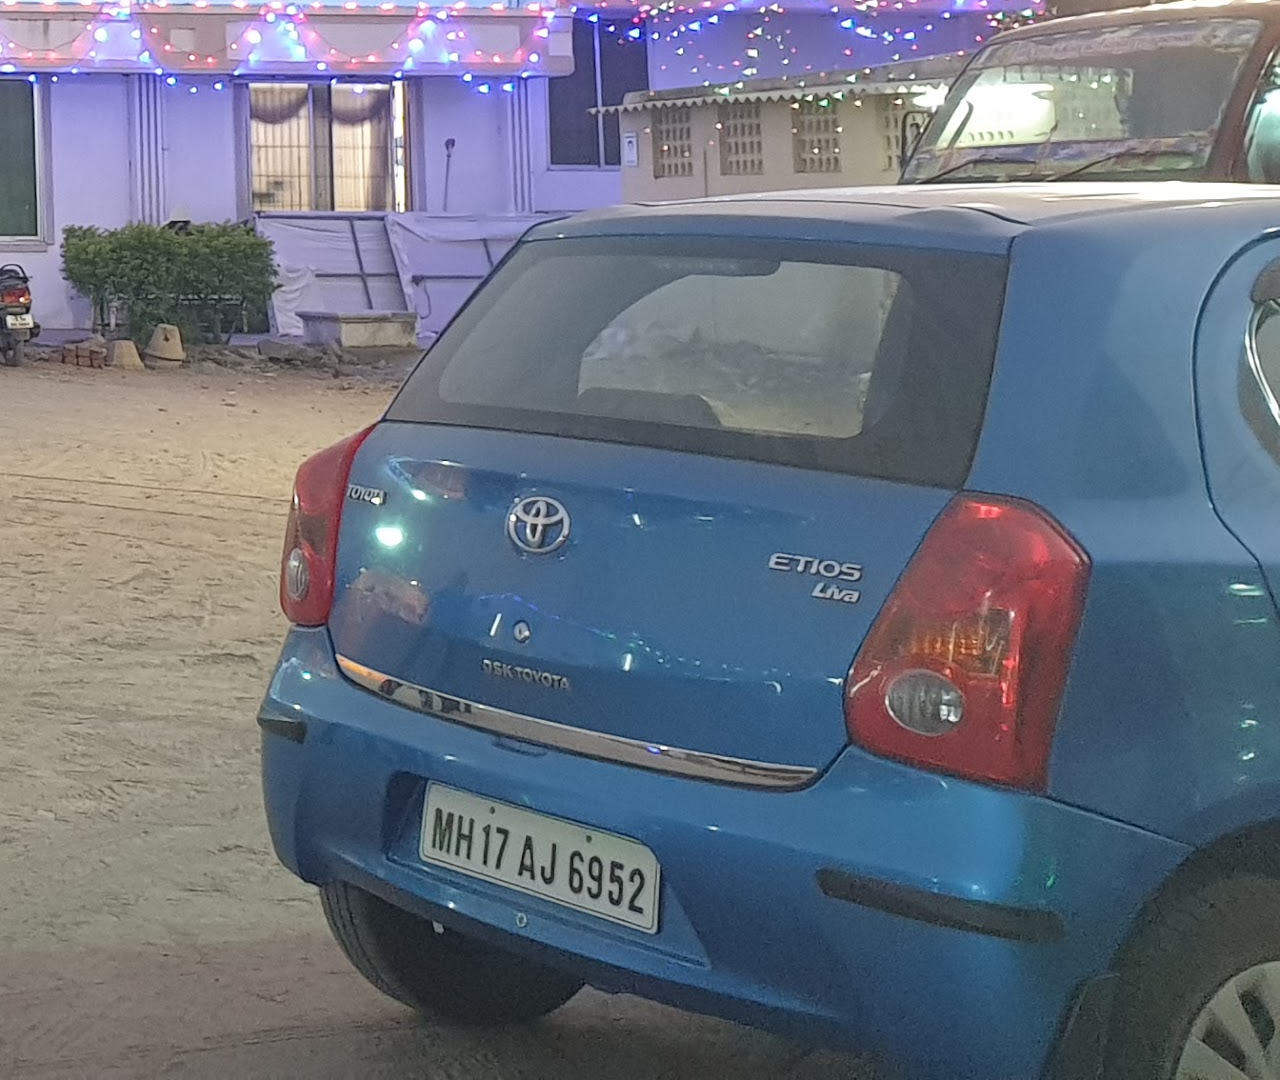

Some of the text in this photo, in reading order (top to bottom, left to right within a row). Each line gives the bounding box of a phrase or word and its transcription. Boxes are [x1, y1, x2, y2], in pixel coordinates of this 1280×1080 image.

[768, 552, 862, 581] ETIOS
[811, 582, 860, 603] Liva
[517, 834, 557, 885] AJ
[569, 849, 646, 914] 6952
